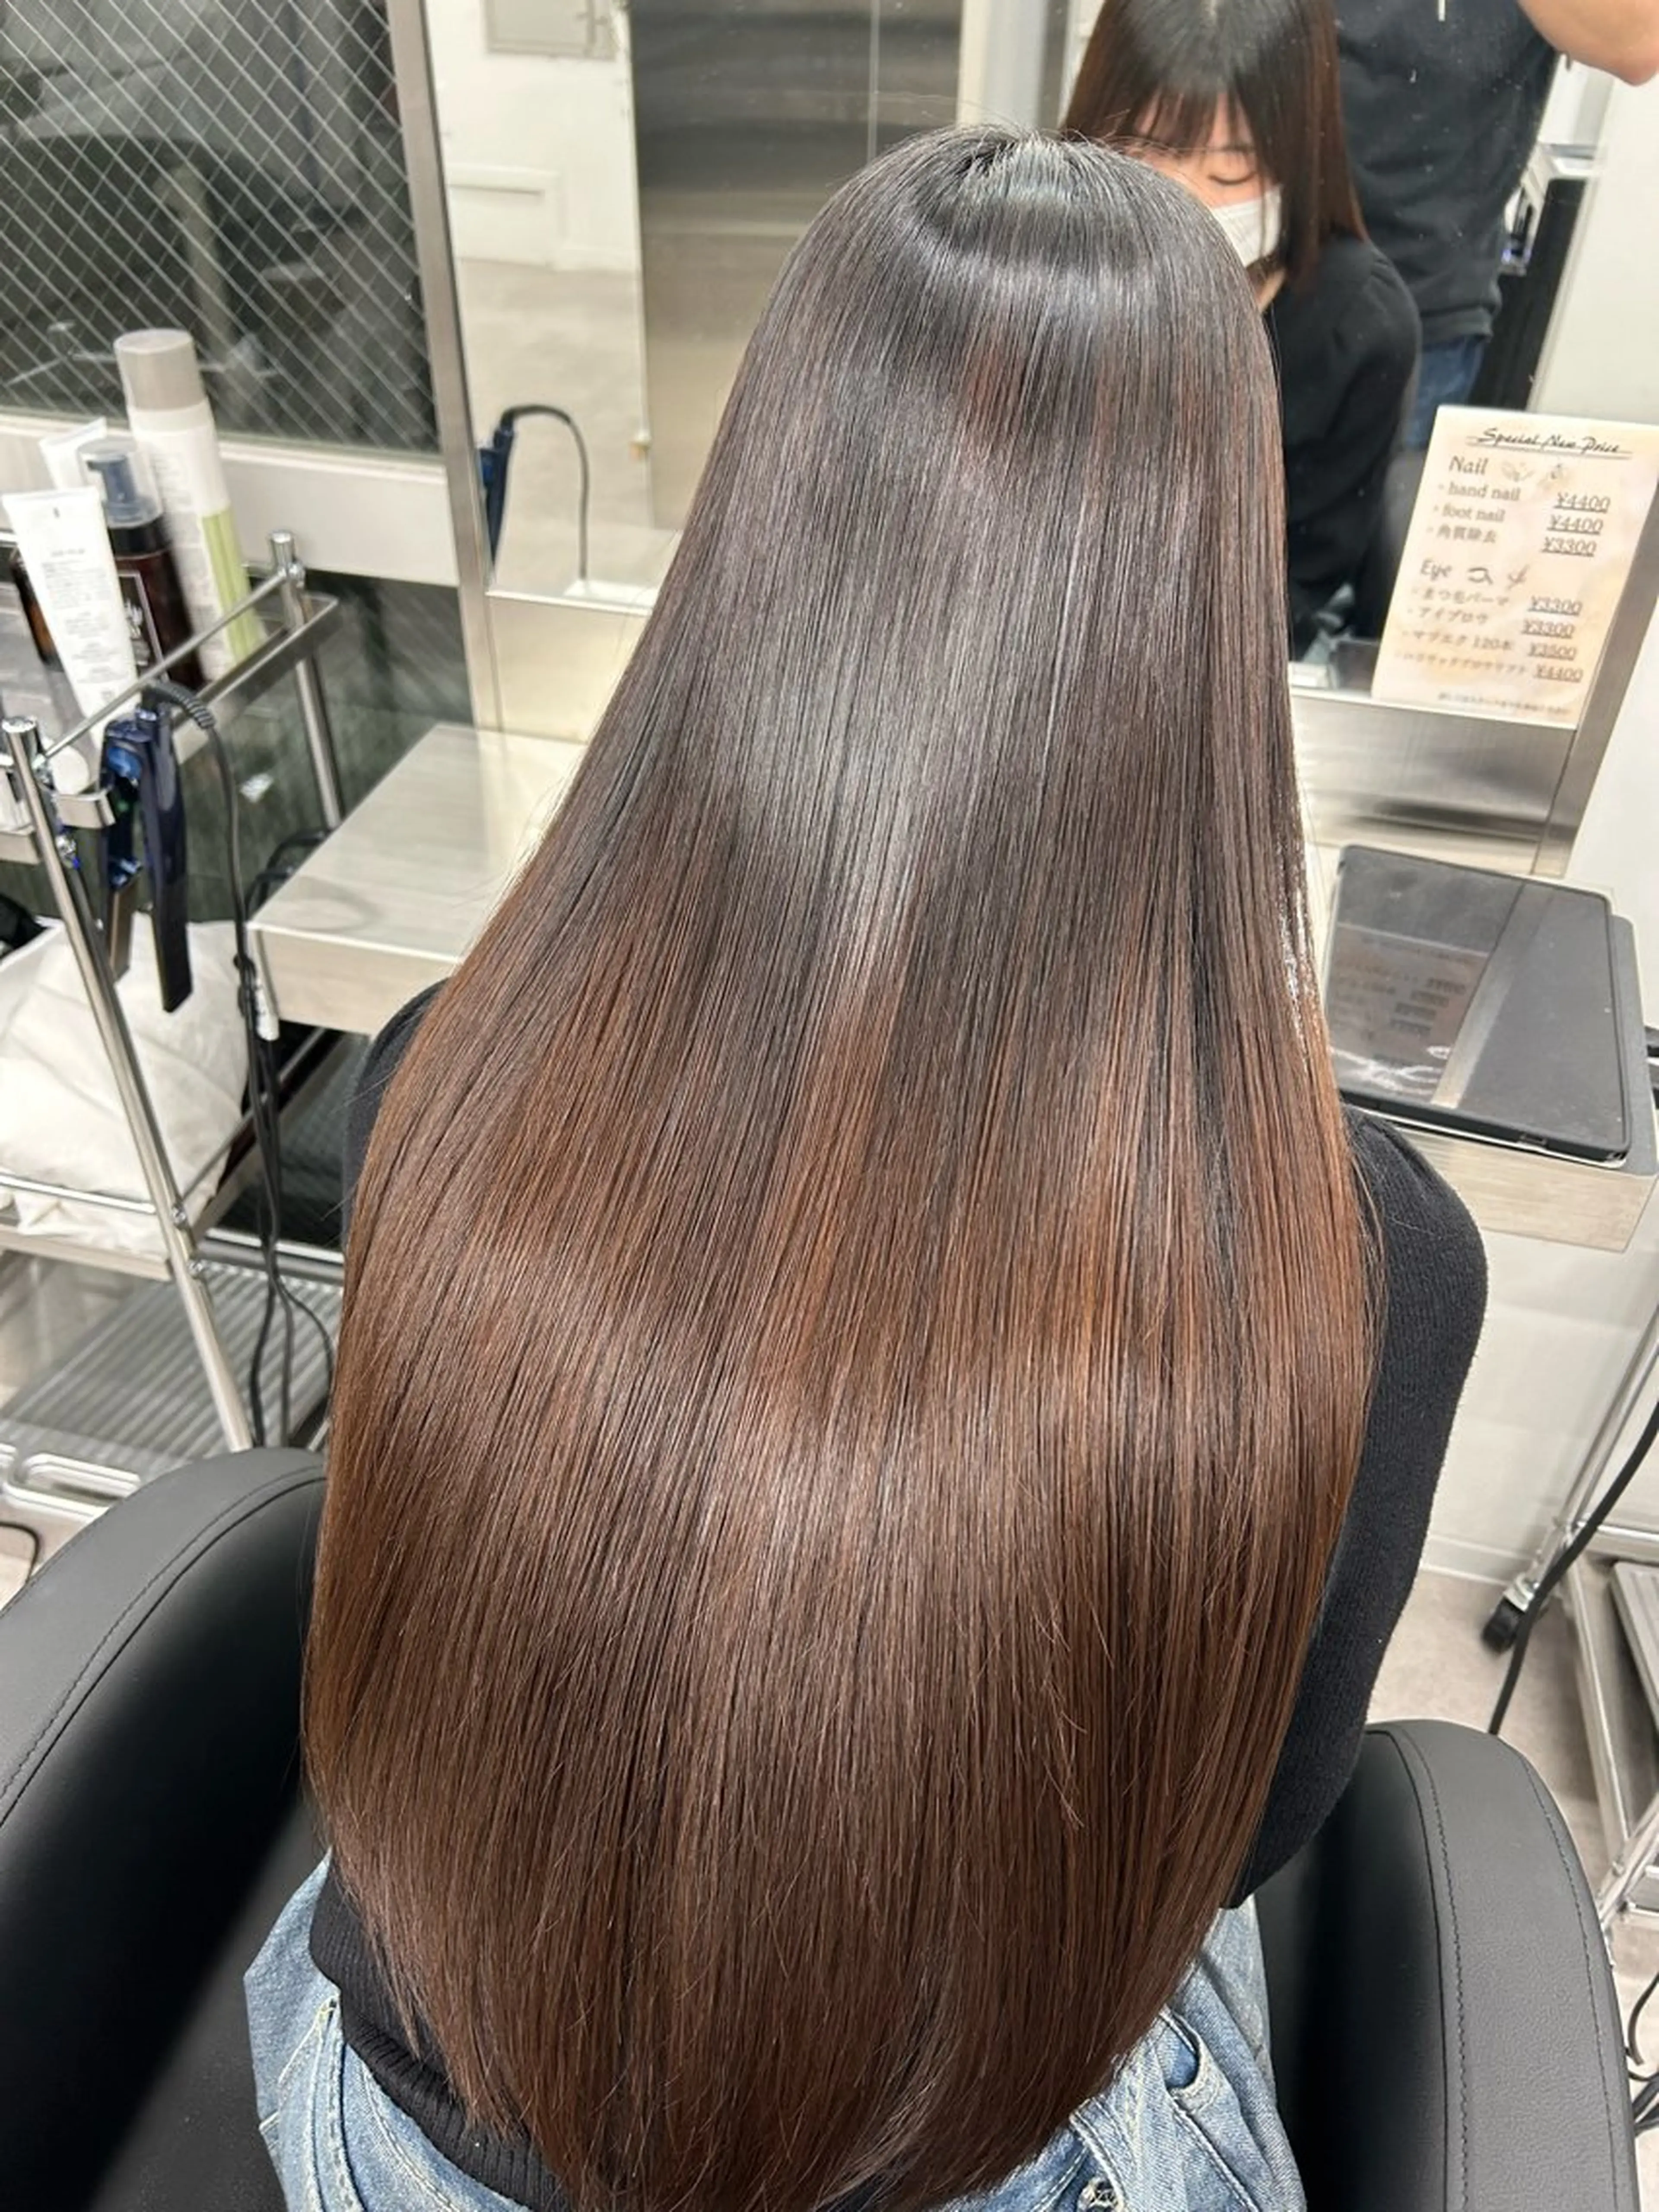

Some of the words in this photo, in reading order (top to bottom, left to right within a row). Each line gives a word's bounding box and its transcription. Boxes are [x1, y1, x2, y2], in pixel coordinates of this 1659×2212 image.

[1478, 427, 1539, 447] Special
[1580, 436, 1620, 454] Price
[1449, 455, 1489, 475] Nail
[1448, 480, 1489, 499] hand
[1491, 487, 1521, 502] nail
[1555, 492, 1611, 513] ¥4400
[1442, 502, 1472, 520] foot
[1475, 507, 1506, 523] nail
[1548, 514, 1604, 535] ¥4400
[1420, 560, 1452, 582] Eye
